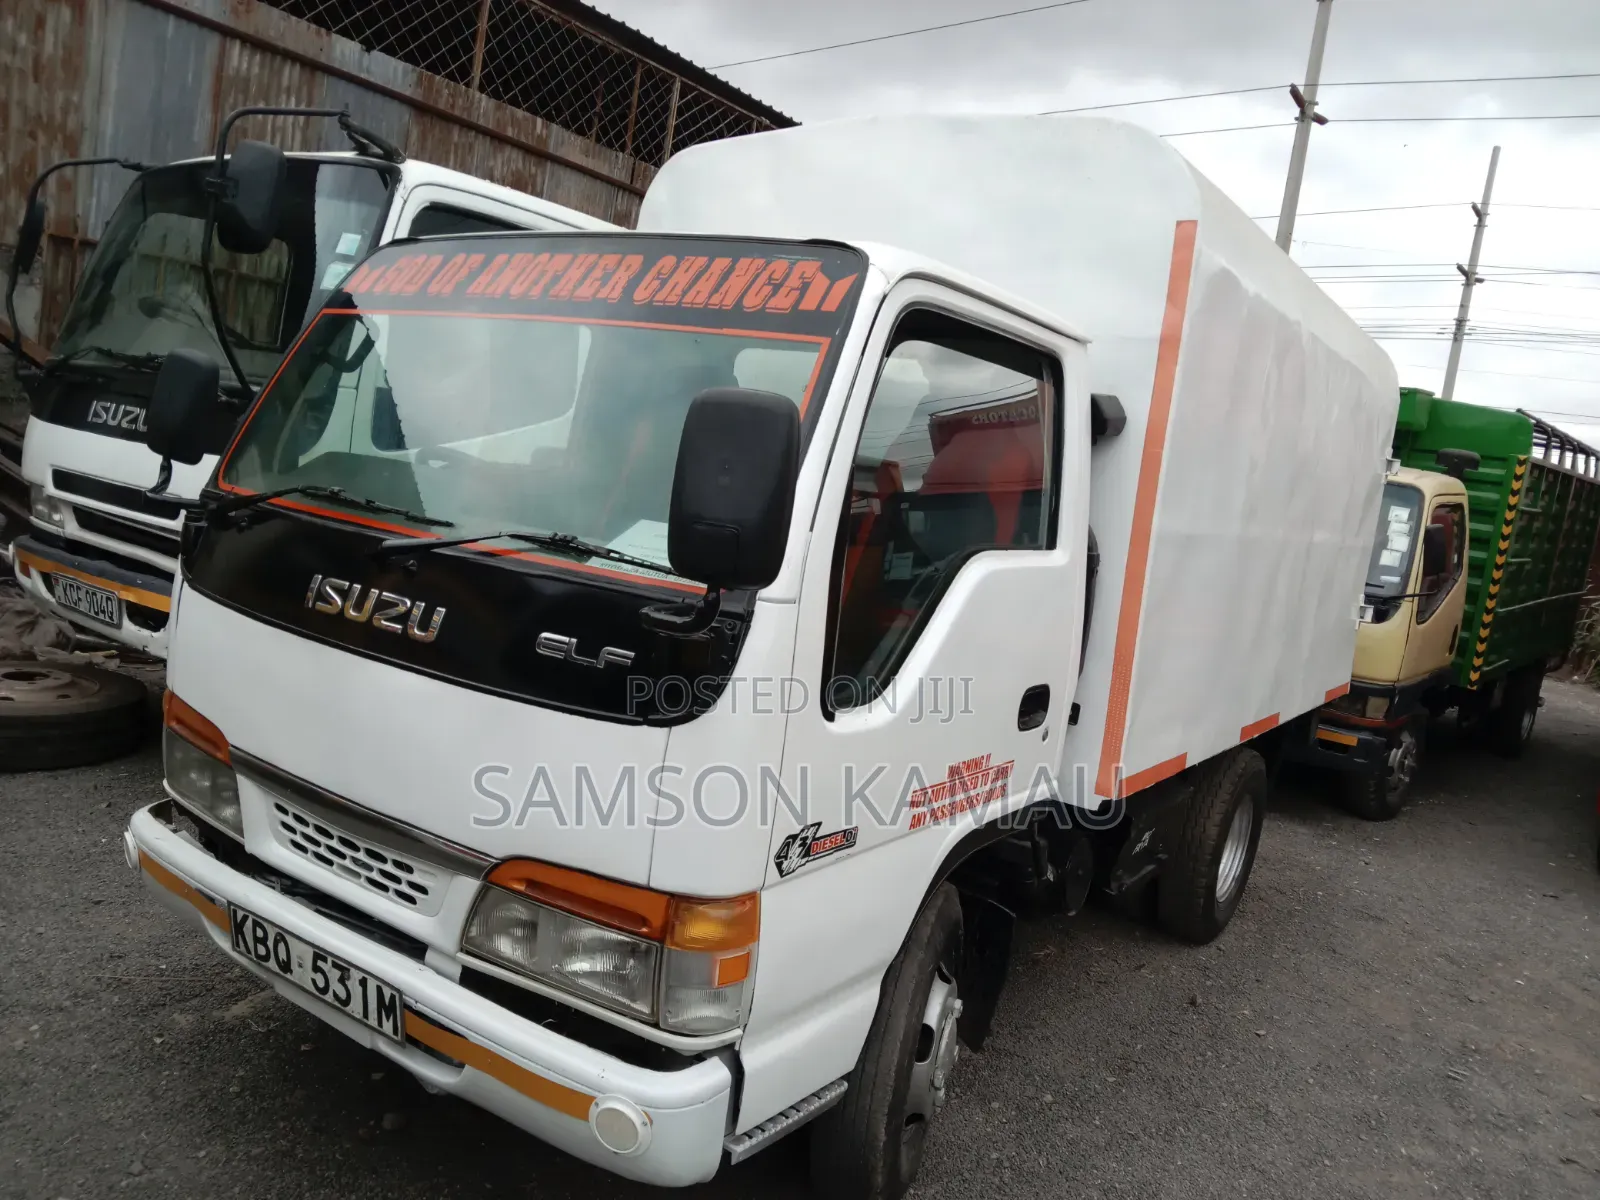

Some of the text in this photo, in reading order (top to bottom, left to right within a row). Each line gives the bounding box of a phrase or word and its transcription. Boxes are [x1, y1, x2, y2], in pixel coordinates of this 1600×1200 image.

[427, 252, 486, 297] OF
[465, 252, 644, 303] ANOTHER
[633, 254, 823, 313] CHANCE
[85, 589, 115, 622] 904Q
[305, 573, 447, 643] ISUZU
[535, 631, 636, 668] ELF
[946, 755, 985, 779] WARNING
[909, 764, 1015, 811] NOT AUTHORISED TO CARRY
[908, 812, 928, 831] ANY
[810, 831, 846, 855] DIESEL
[232, 908, 399, 1037] KBQ 531M
